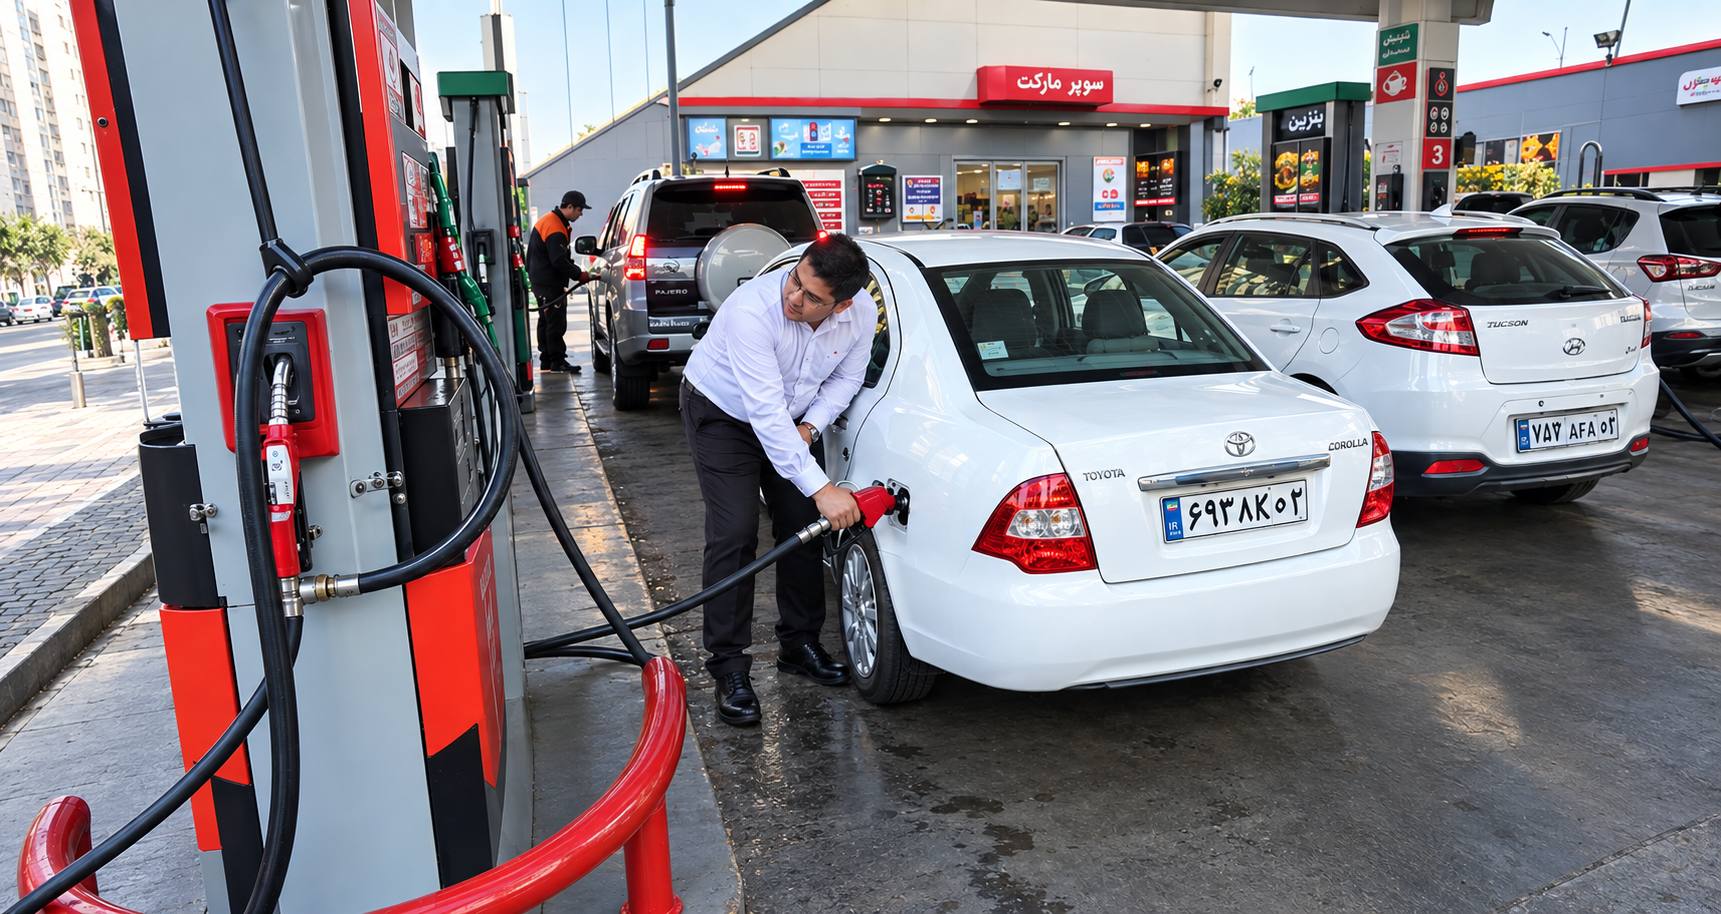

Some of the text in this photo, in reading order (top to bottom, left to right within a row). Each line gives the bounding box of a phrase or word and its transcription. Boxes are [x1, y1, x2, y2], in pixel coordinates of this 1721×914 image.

[1017, 72, 1104, 97] سوپر مارکت
[1288, 109, 1324, 132] بنزین
[1431, 144, 1444, 165] 3
[1487, 319, 1529, 328] TUCSON
[1328, 437, 1369, 451] COROLLA
[1082, 468, 1126, 481] TOYOTA
[1168, 521, 1179, 531] IR
